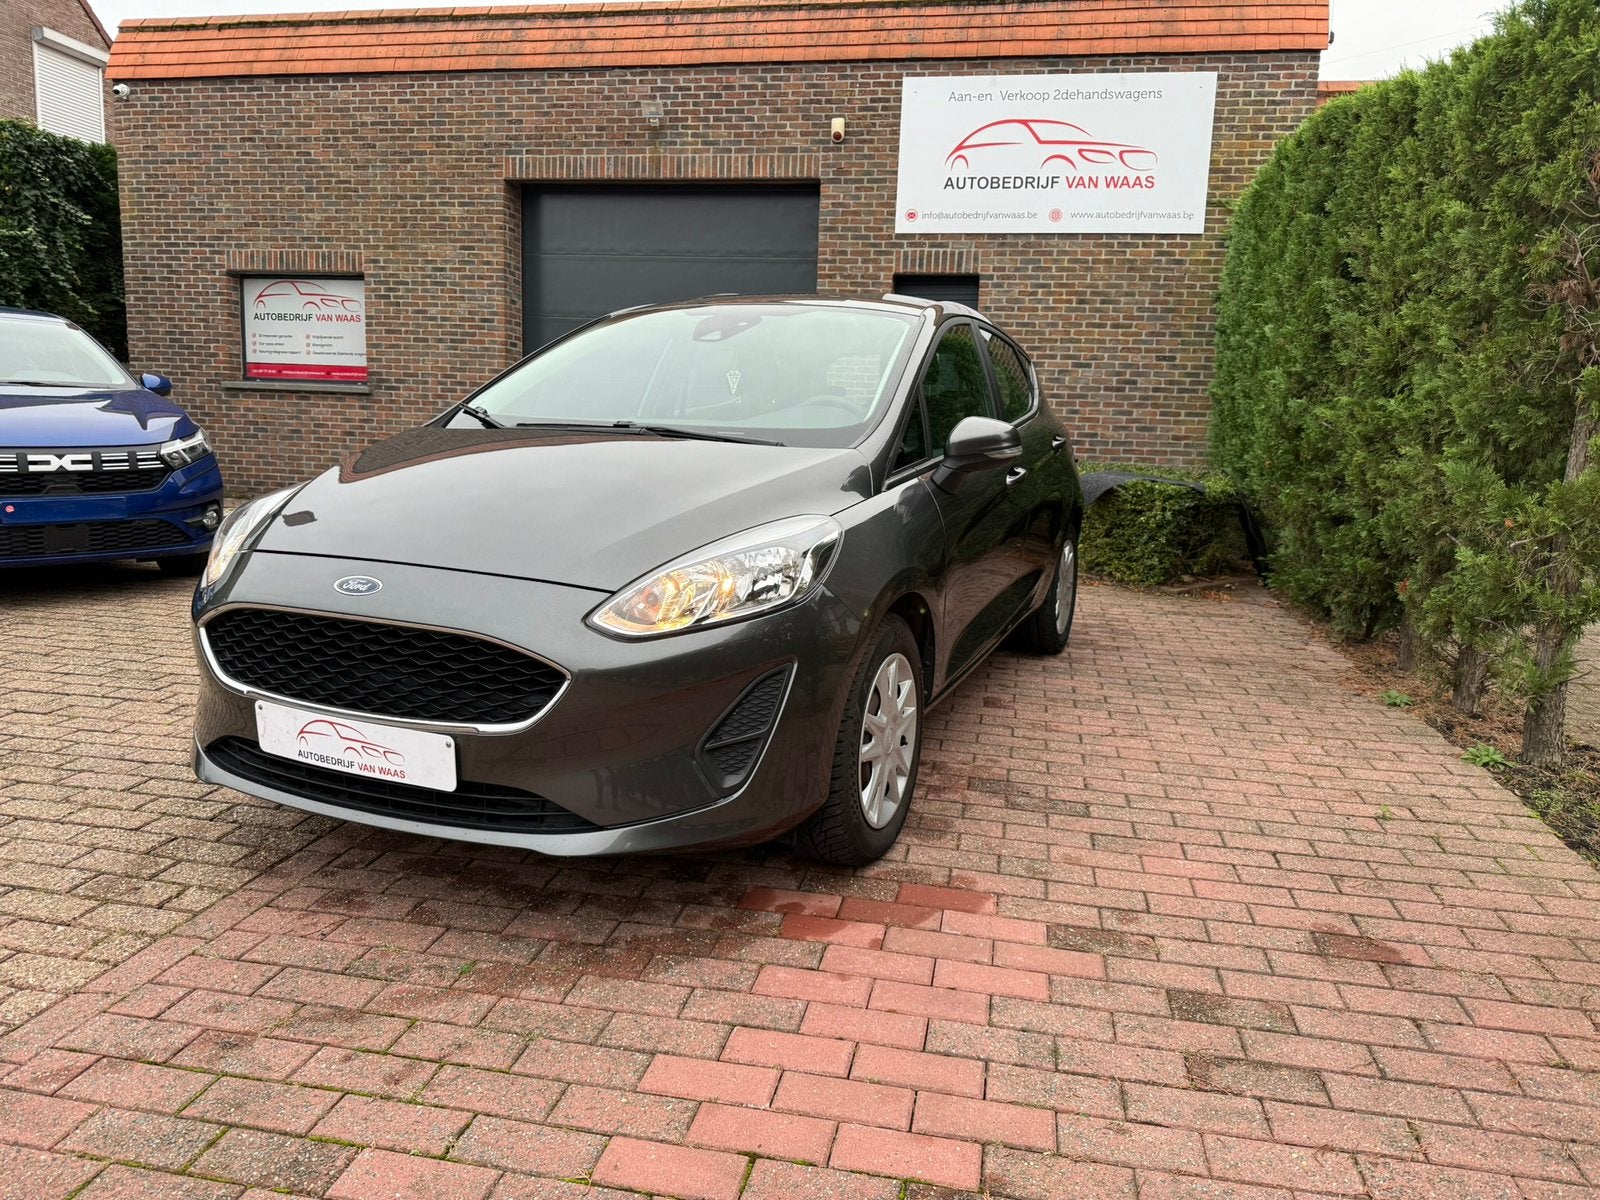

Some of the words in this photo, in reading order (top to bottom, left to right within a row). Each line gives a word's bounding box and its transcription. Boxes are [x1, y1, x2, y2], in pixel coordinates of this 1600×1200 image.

[948, 91, 993, 102] Aan-en
[999, 89, 1050, 103] Verkoop
[1053, 89, 1163, 102] 2dehandswagens
[944, 176, 1060, 190] AUTOBEDRIJF
[1065, 176, 1099, 189] VAN
[1105, 175, 1155, 189] WAAS
[922, 210, 1038, 221] info@autobedrijfvanwaas.be
[1070, 210, 1195, 221] www.autobedrijfvanwaas.be
[253, 312, 314, 322] AUTOBEDRIJF
[315, 314, 333, 322] VAN
[335, 314, 362, 323] WAAS
[342, 579, 372, 591] Ford
[298, 749, 355, 769] AUTOBEDRIJF
[357, 762, 376, 774] VAN
[377, 766, 406, 779] WAAS
